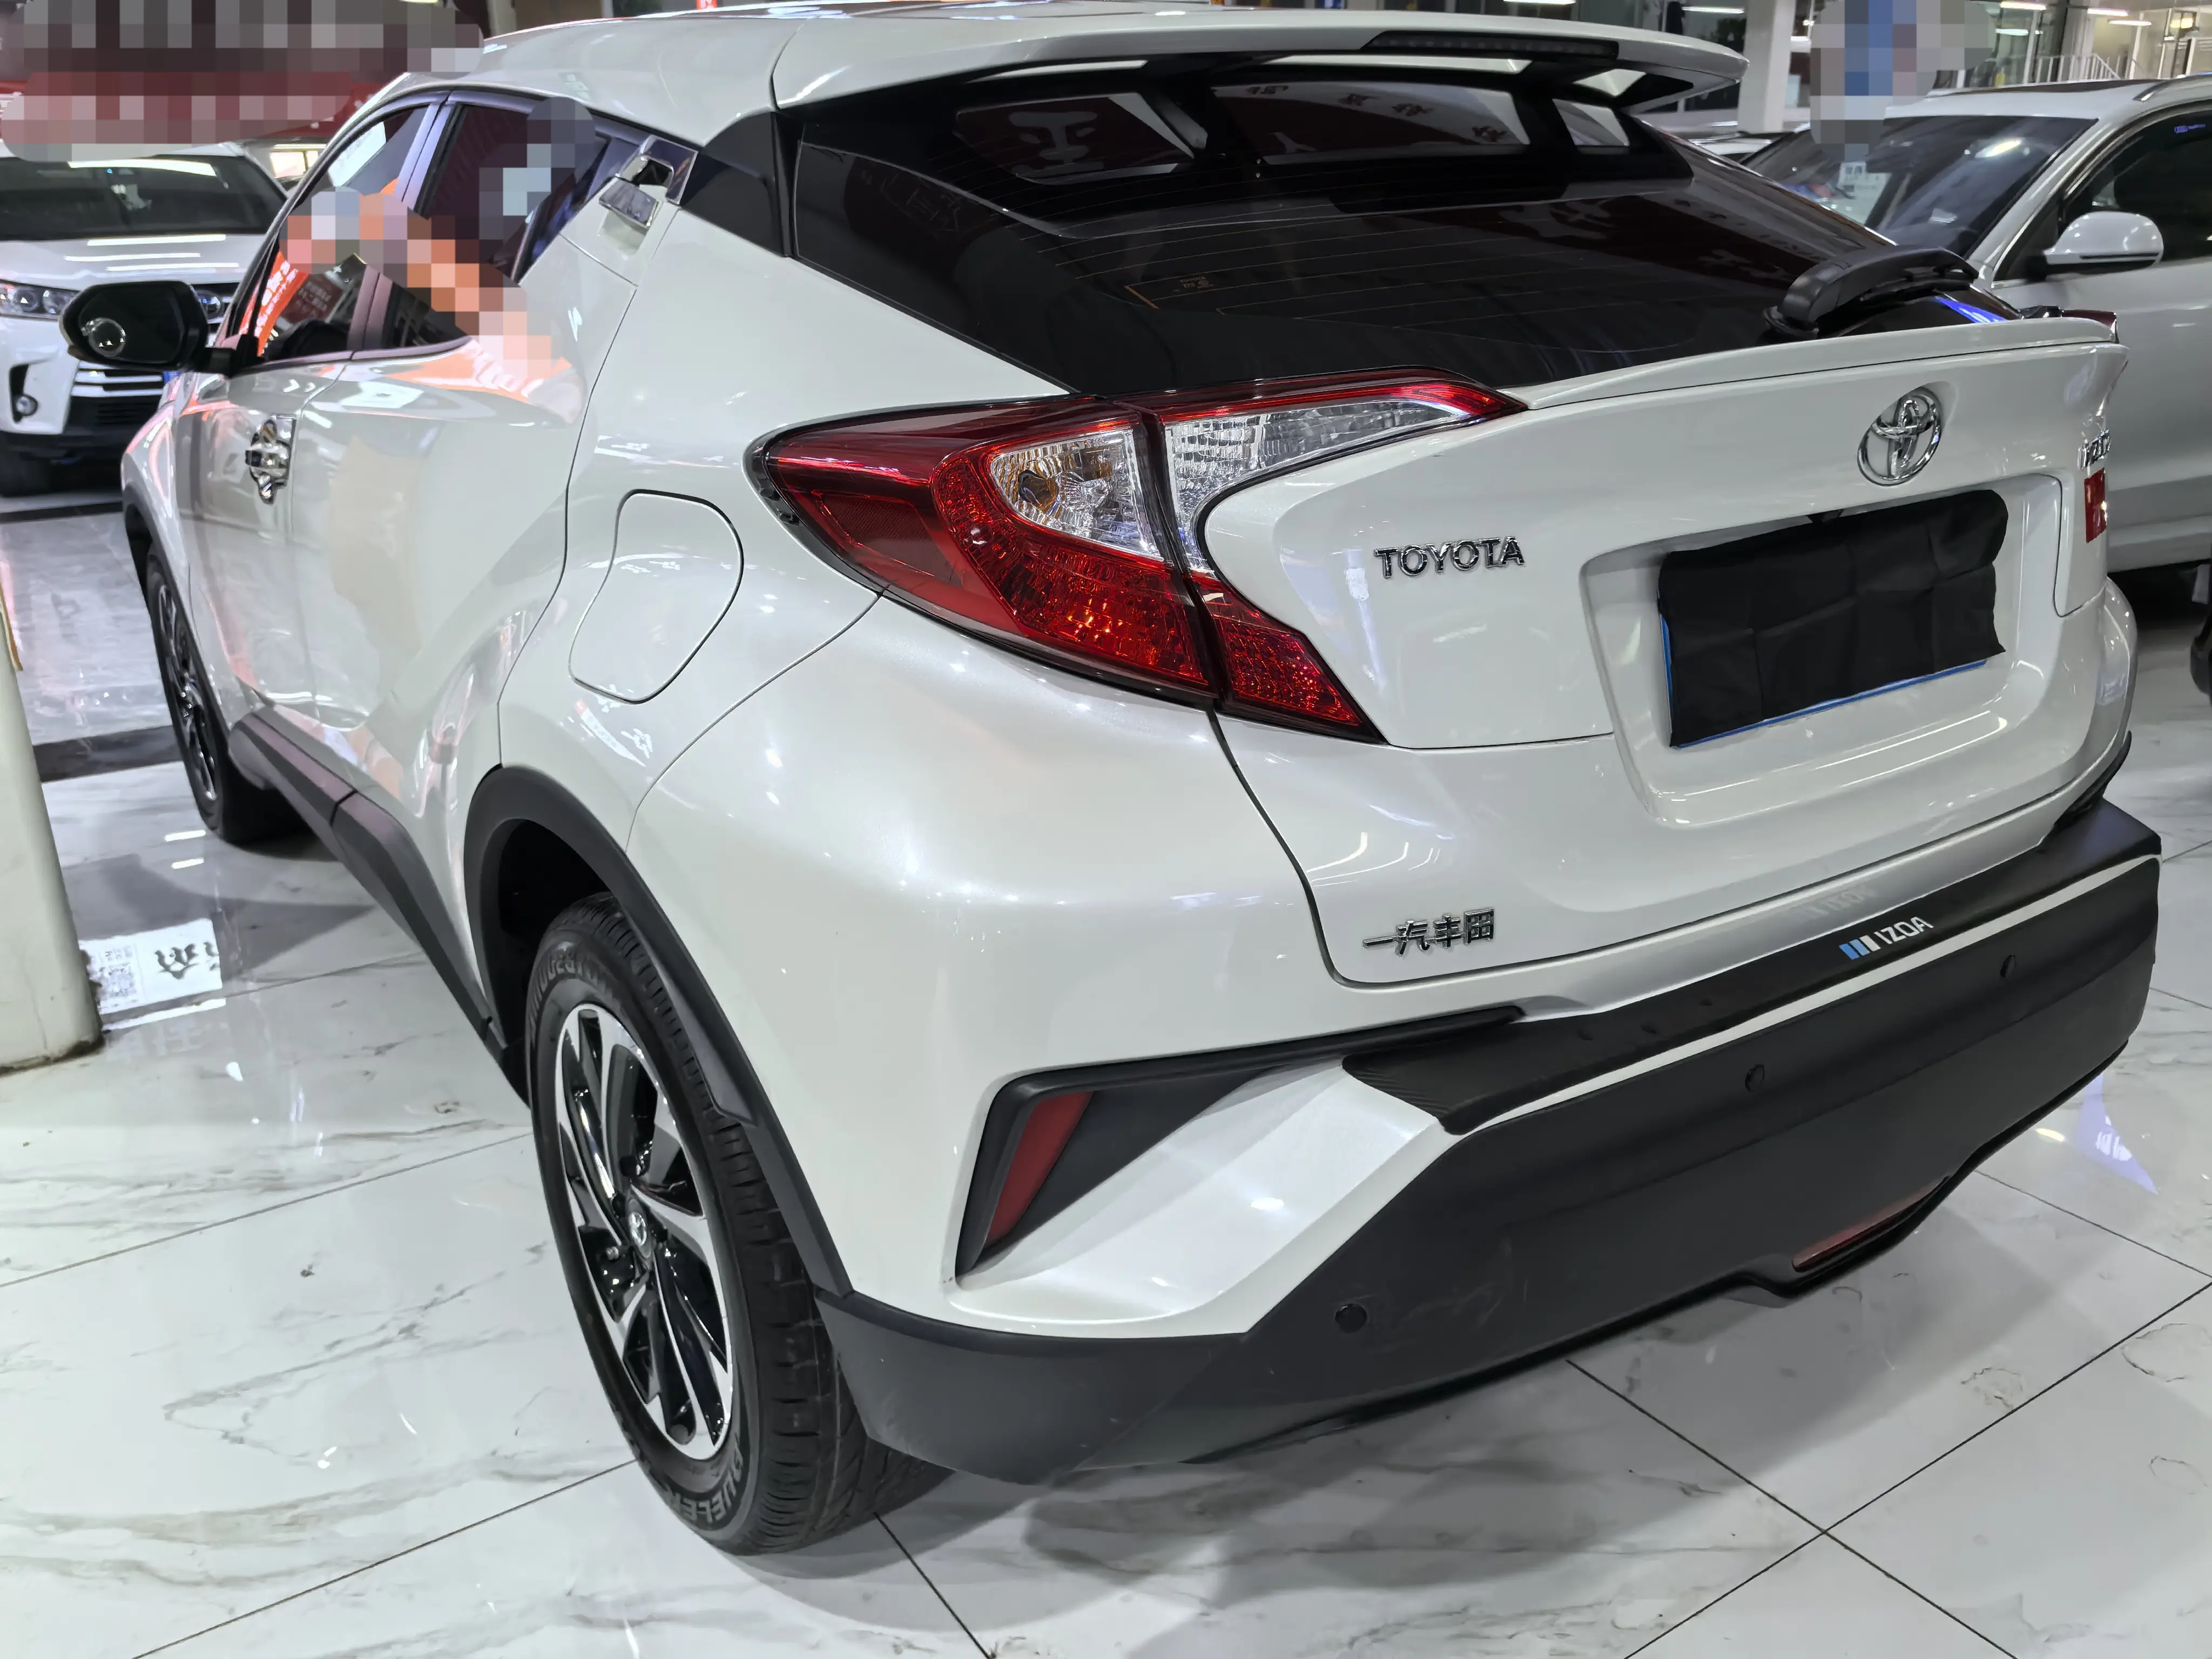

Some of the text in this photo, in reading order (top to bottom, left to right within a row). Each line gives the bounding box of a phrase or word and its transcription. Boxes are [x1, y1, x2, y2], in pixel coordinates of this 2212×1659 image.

[1373, 536, 1526, 578] TOYOTA
[1362, 907, 1495, 957] 一汽丰田
